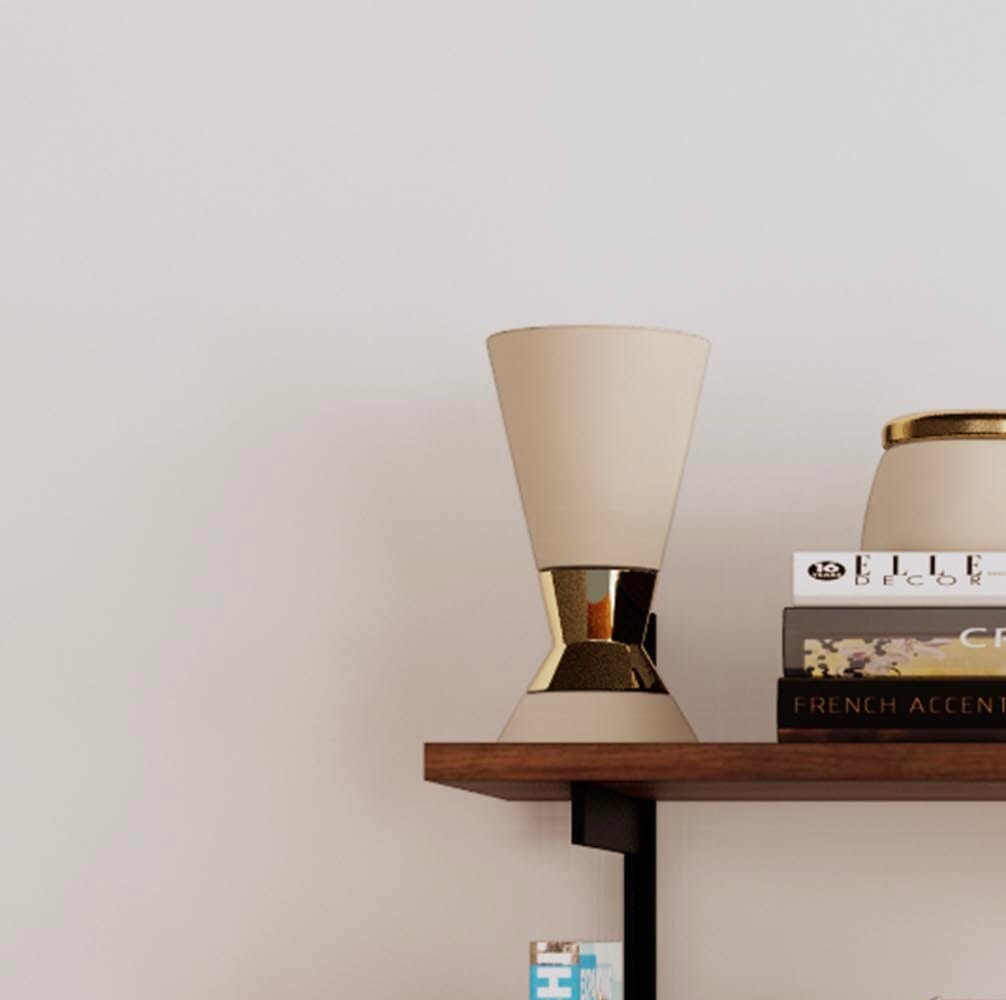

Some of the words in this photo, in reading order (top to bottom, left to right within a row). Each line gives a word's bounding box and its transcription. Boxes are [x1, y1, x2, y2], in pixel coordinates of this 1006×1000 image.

[855, 555, 983, 576] ELLE
[855, 575, 983, 587] DECOR
[794, 696, 896, 715] FRENCH
